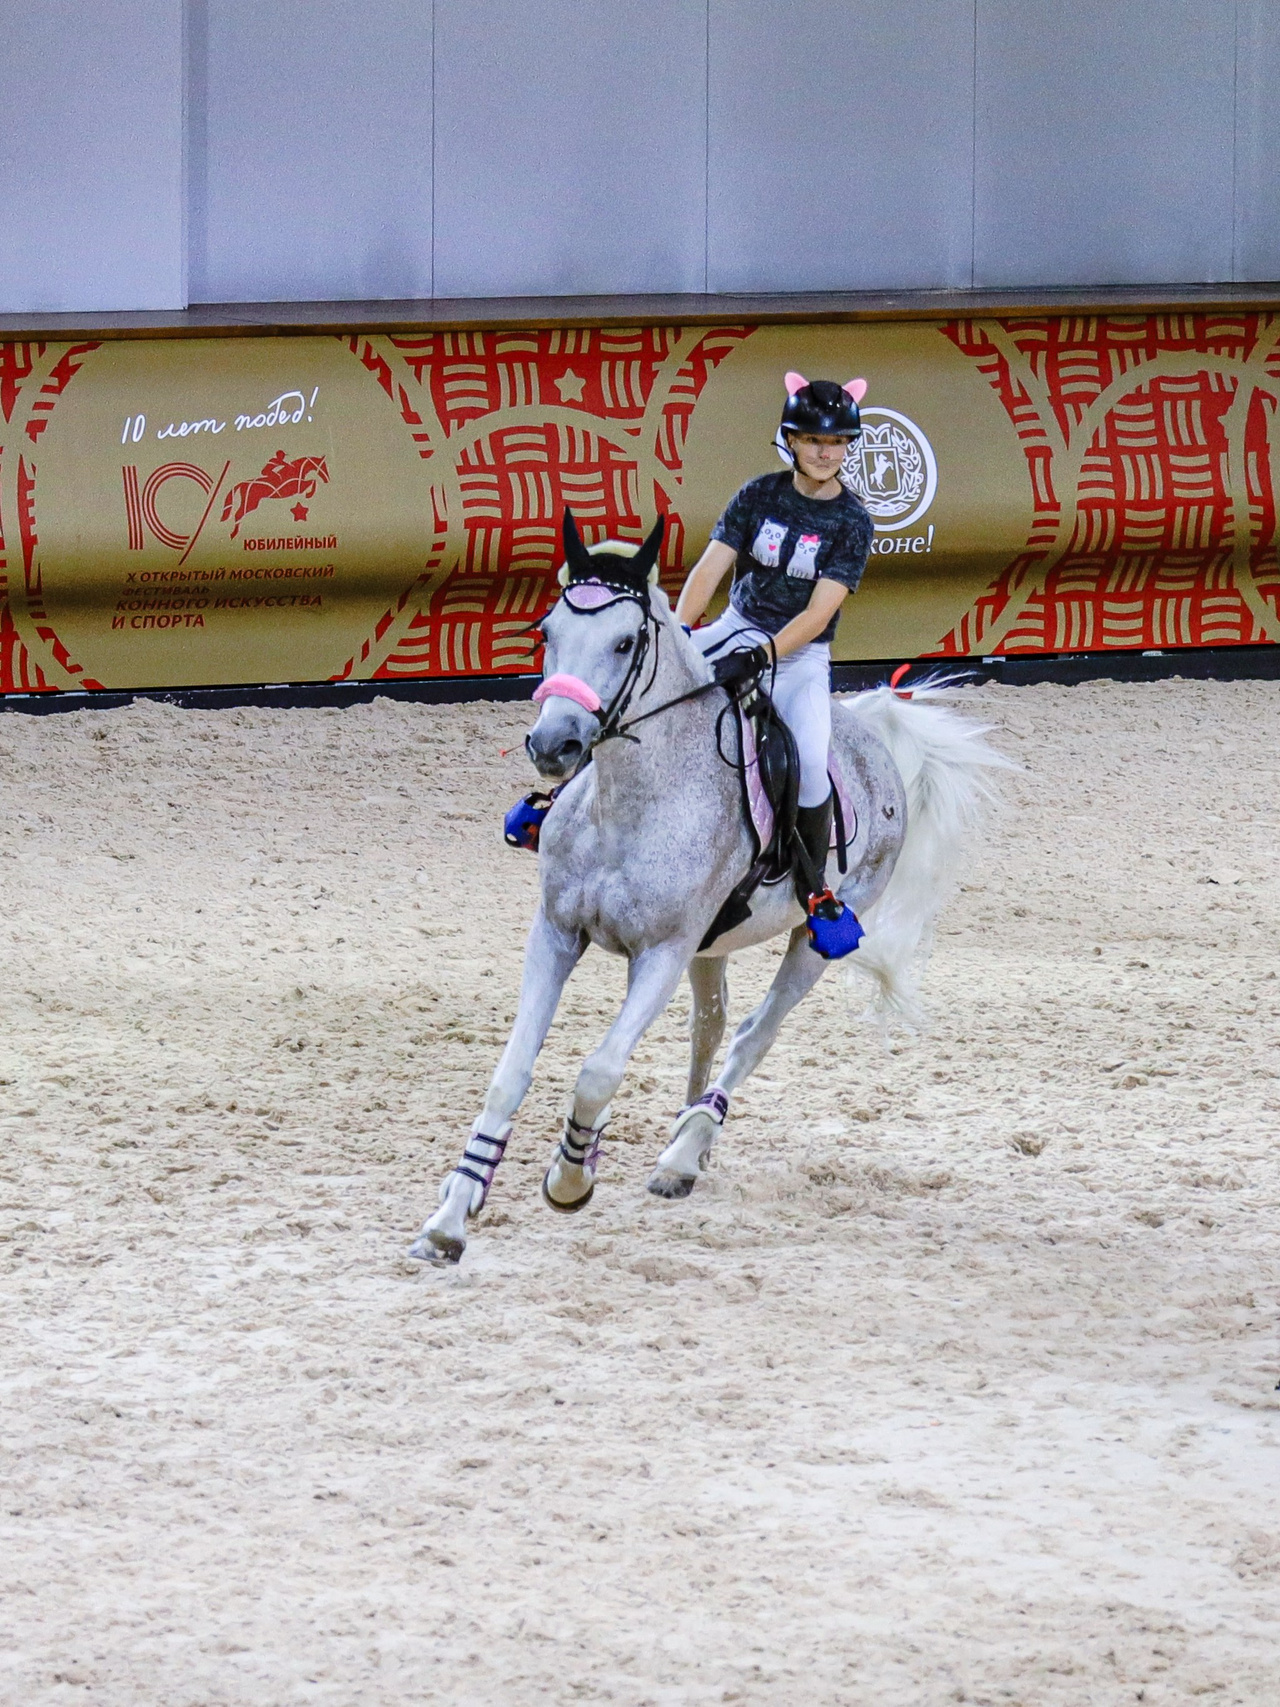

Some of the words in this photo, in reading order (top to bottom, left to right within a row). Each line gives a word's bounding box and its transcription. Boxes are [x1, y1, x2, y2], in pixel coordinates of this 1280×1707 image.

[120, 414, 146, 444] 10
[157, 418, 226, 440] лет
[234, 386, 319, 431] побед!
[243, 534, 338, 551] ЮБИЛЕЙНЫЙ
[140, 567, 226, 583] ОТКРЫТЫЙ
[229, 564, 335, 580] МОСКОВСКИЙ
[121, 585, 211, 597] ФЕСТИВАЛЬ
[115, 598, 209, 612] КОННОГО
[213, 595, 323, 610] ИСКУССТВА
[111, 616, 126, 630] И
[130, 614, 206, 629] СПОРТА
